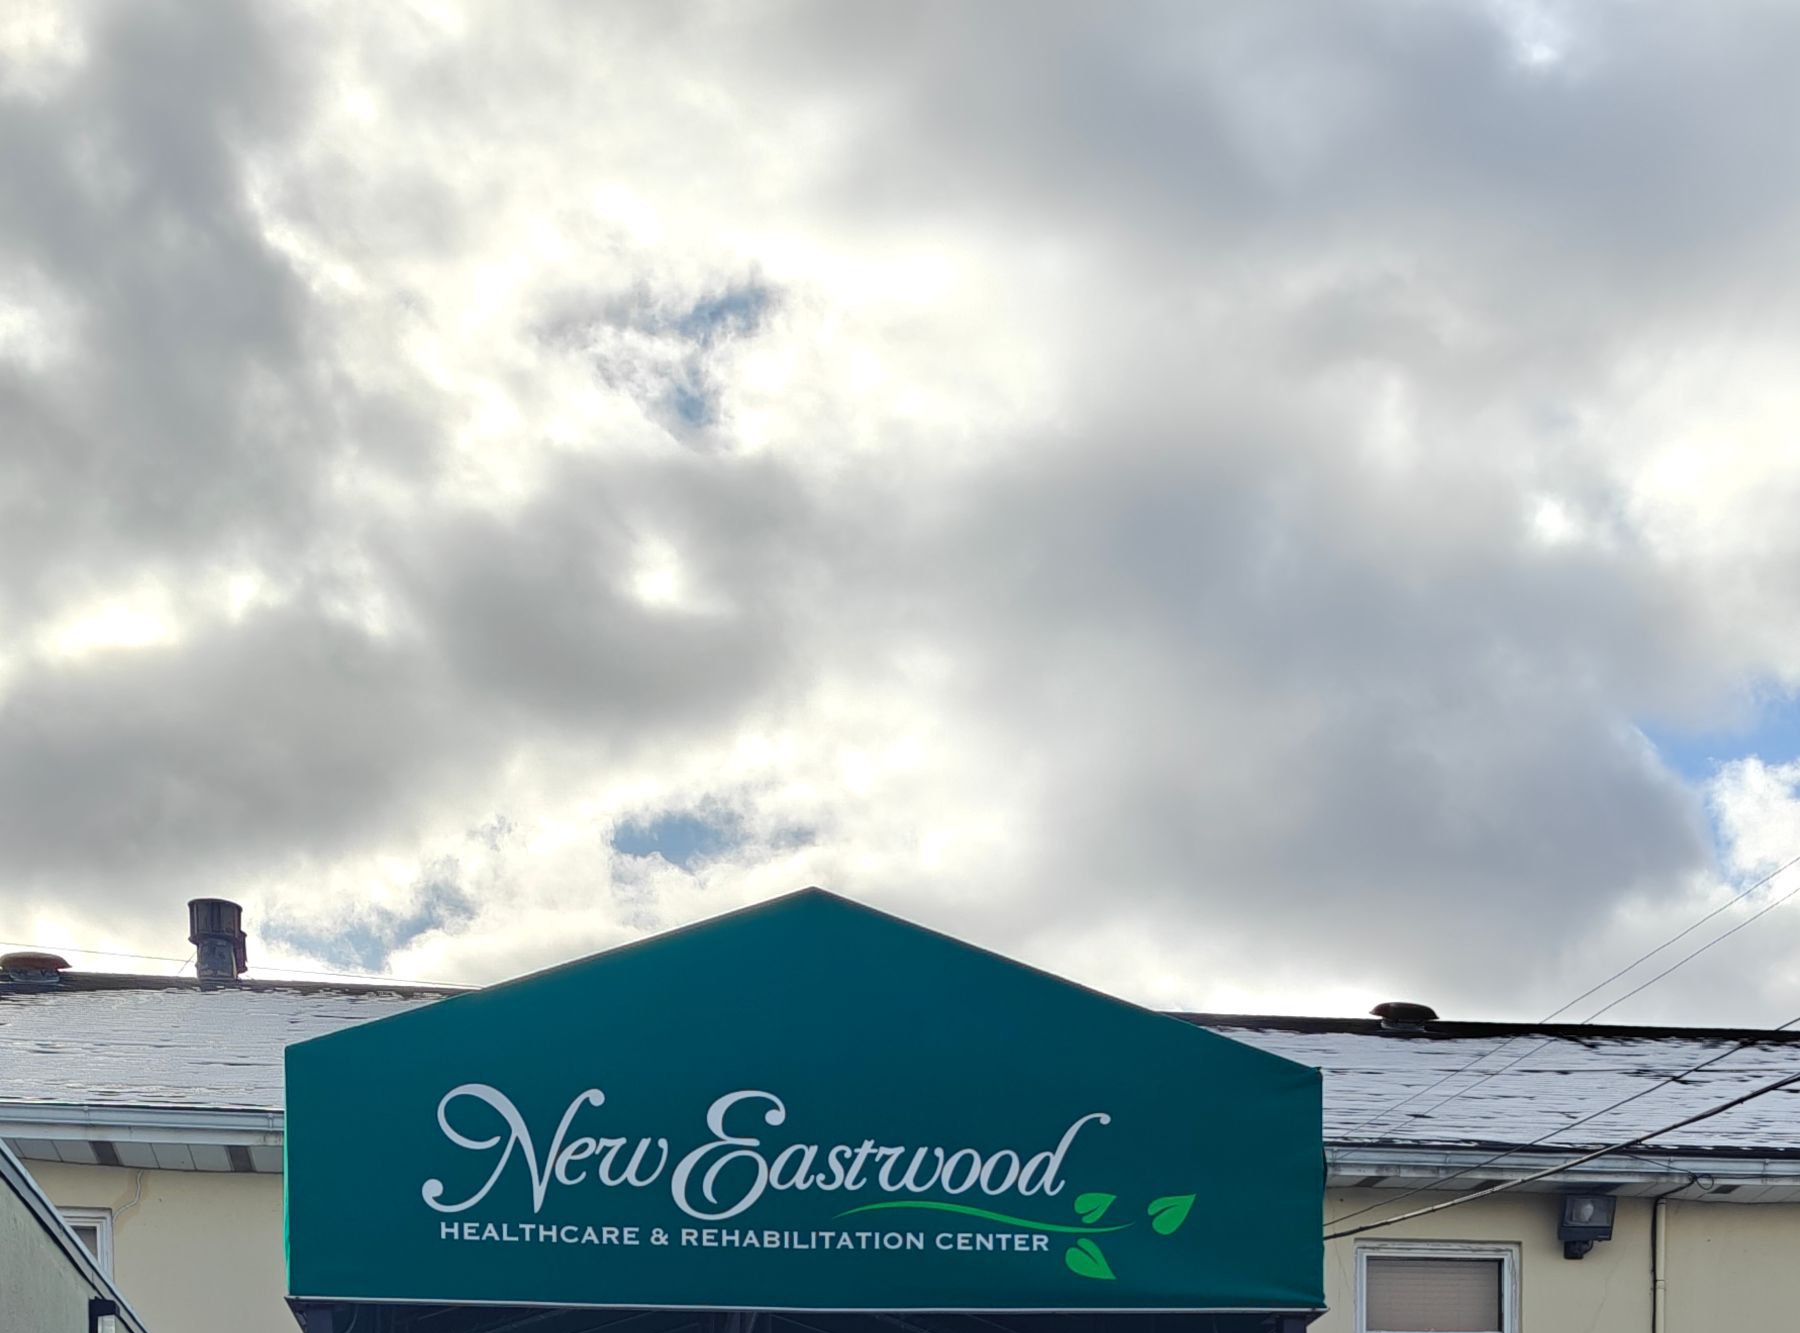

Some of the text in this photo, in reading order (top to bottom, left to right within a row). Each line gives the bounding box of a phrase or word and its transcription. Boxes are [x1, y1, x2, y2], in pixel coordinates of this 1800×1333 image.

[422, 1084, 1111, 1220] New Eastwood
[440, 1221, 1049, 1251] HEALTHCARE & REHABILITATION CENTER
